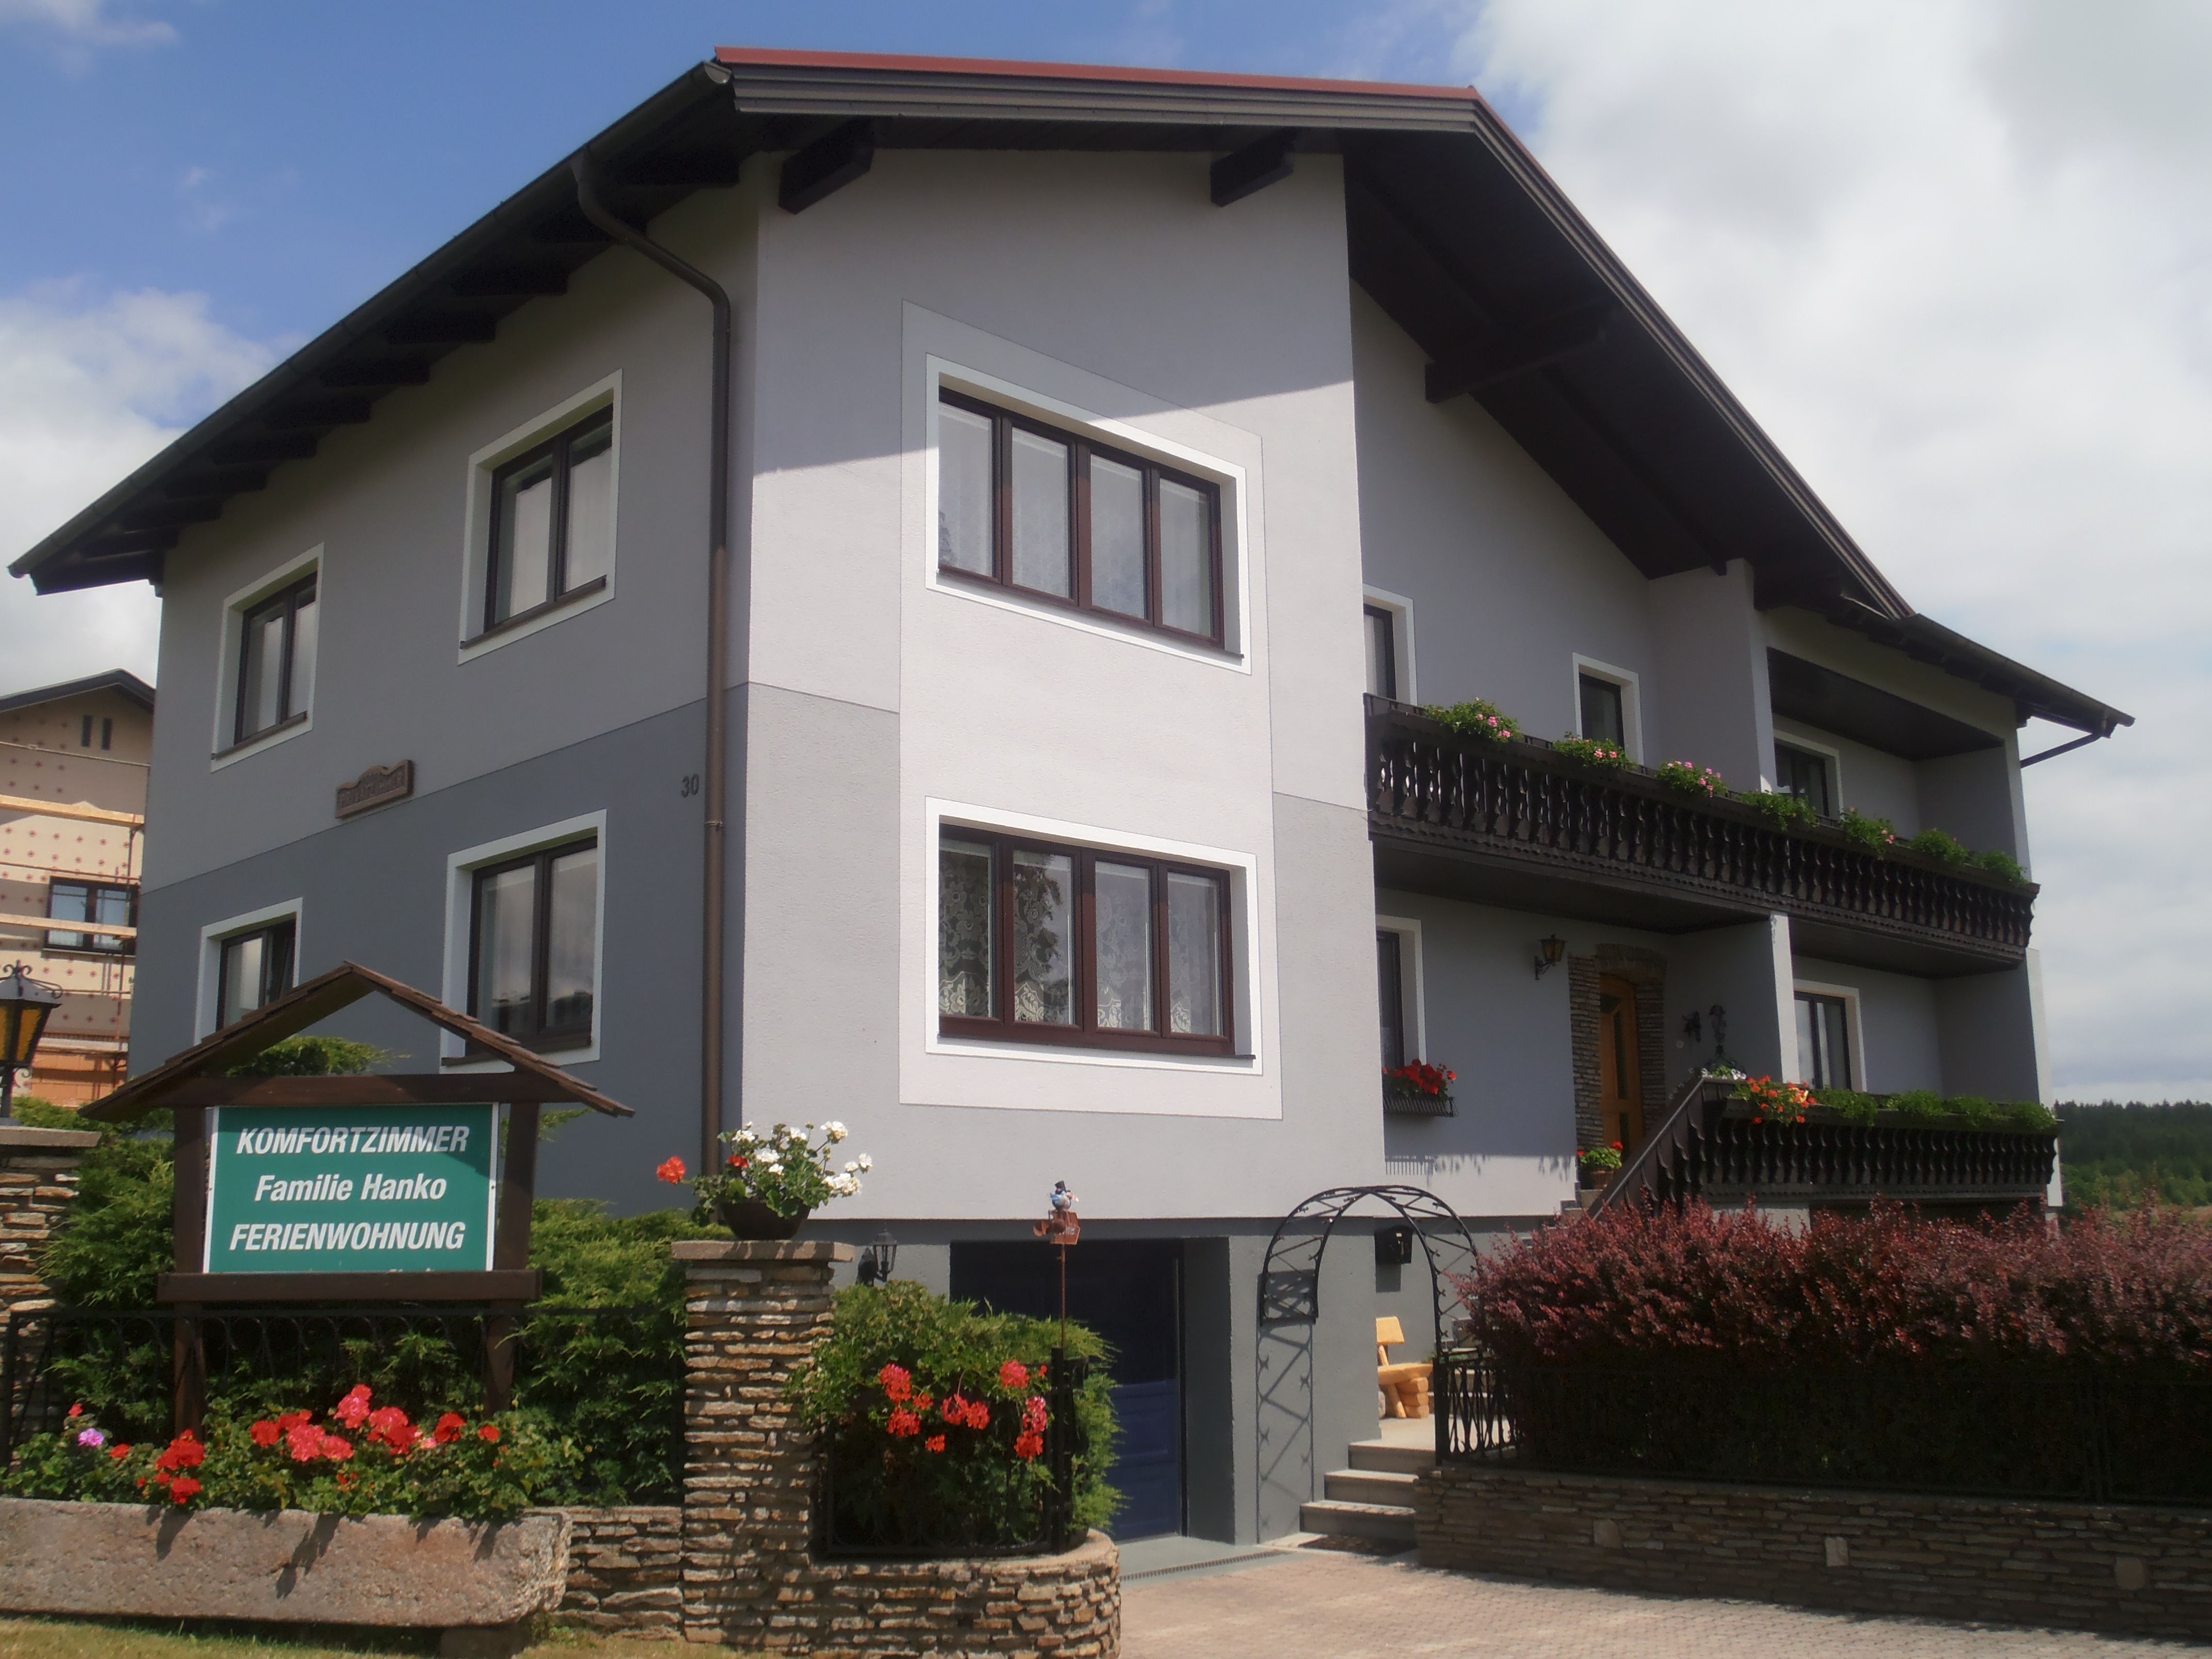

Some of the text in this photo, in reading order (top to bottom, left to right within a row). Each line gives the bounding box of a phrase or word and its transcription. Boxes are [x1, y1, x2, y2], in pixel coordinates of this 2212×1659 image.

[681, 774, 699, 798] 30
[236, 1126, 469, 1154] KOMFORTZIMMER
[254, 1173, 447, 1201] Familie Hanko
[230, 1222, 466, 1251] FERIENWOHNUNG
